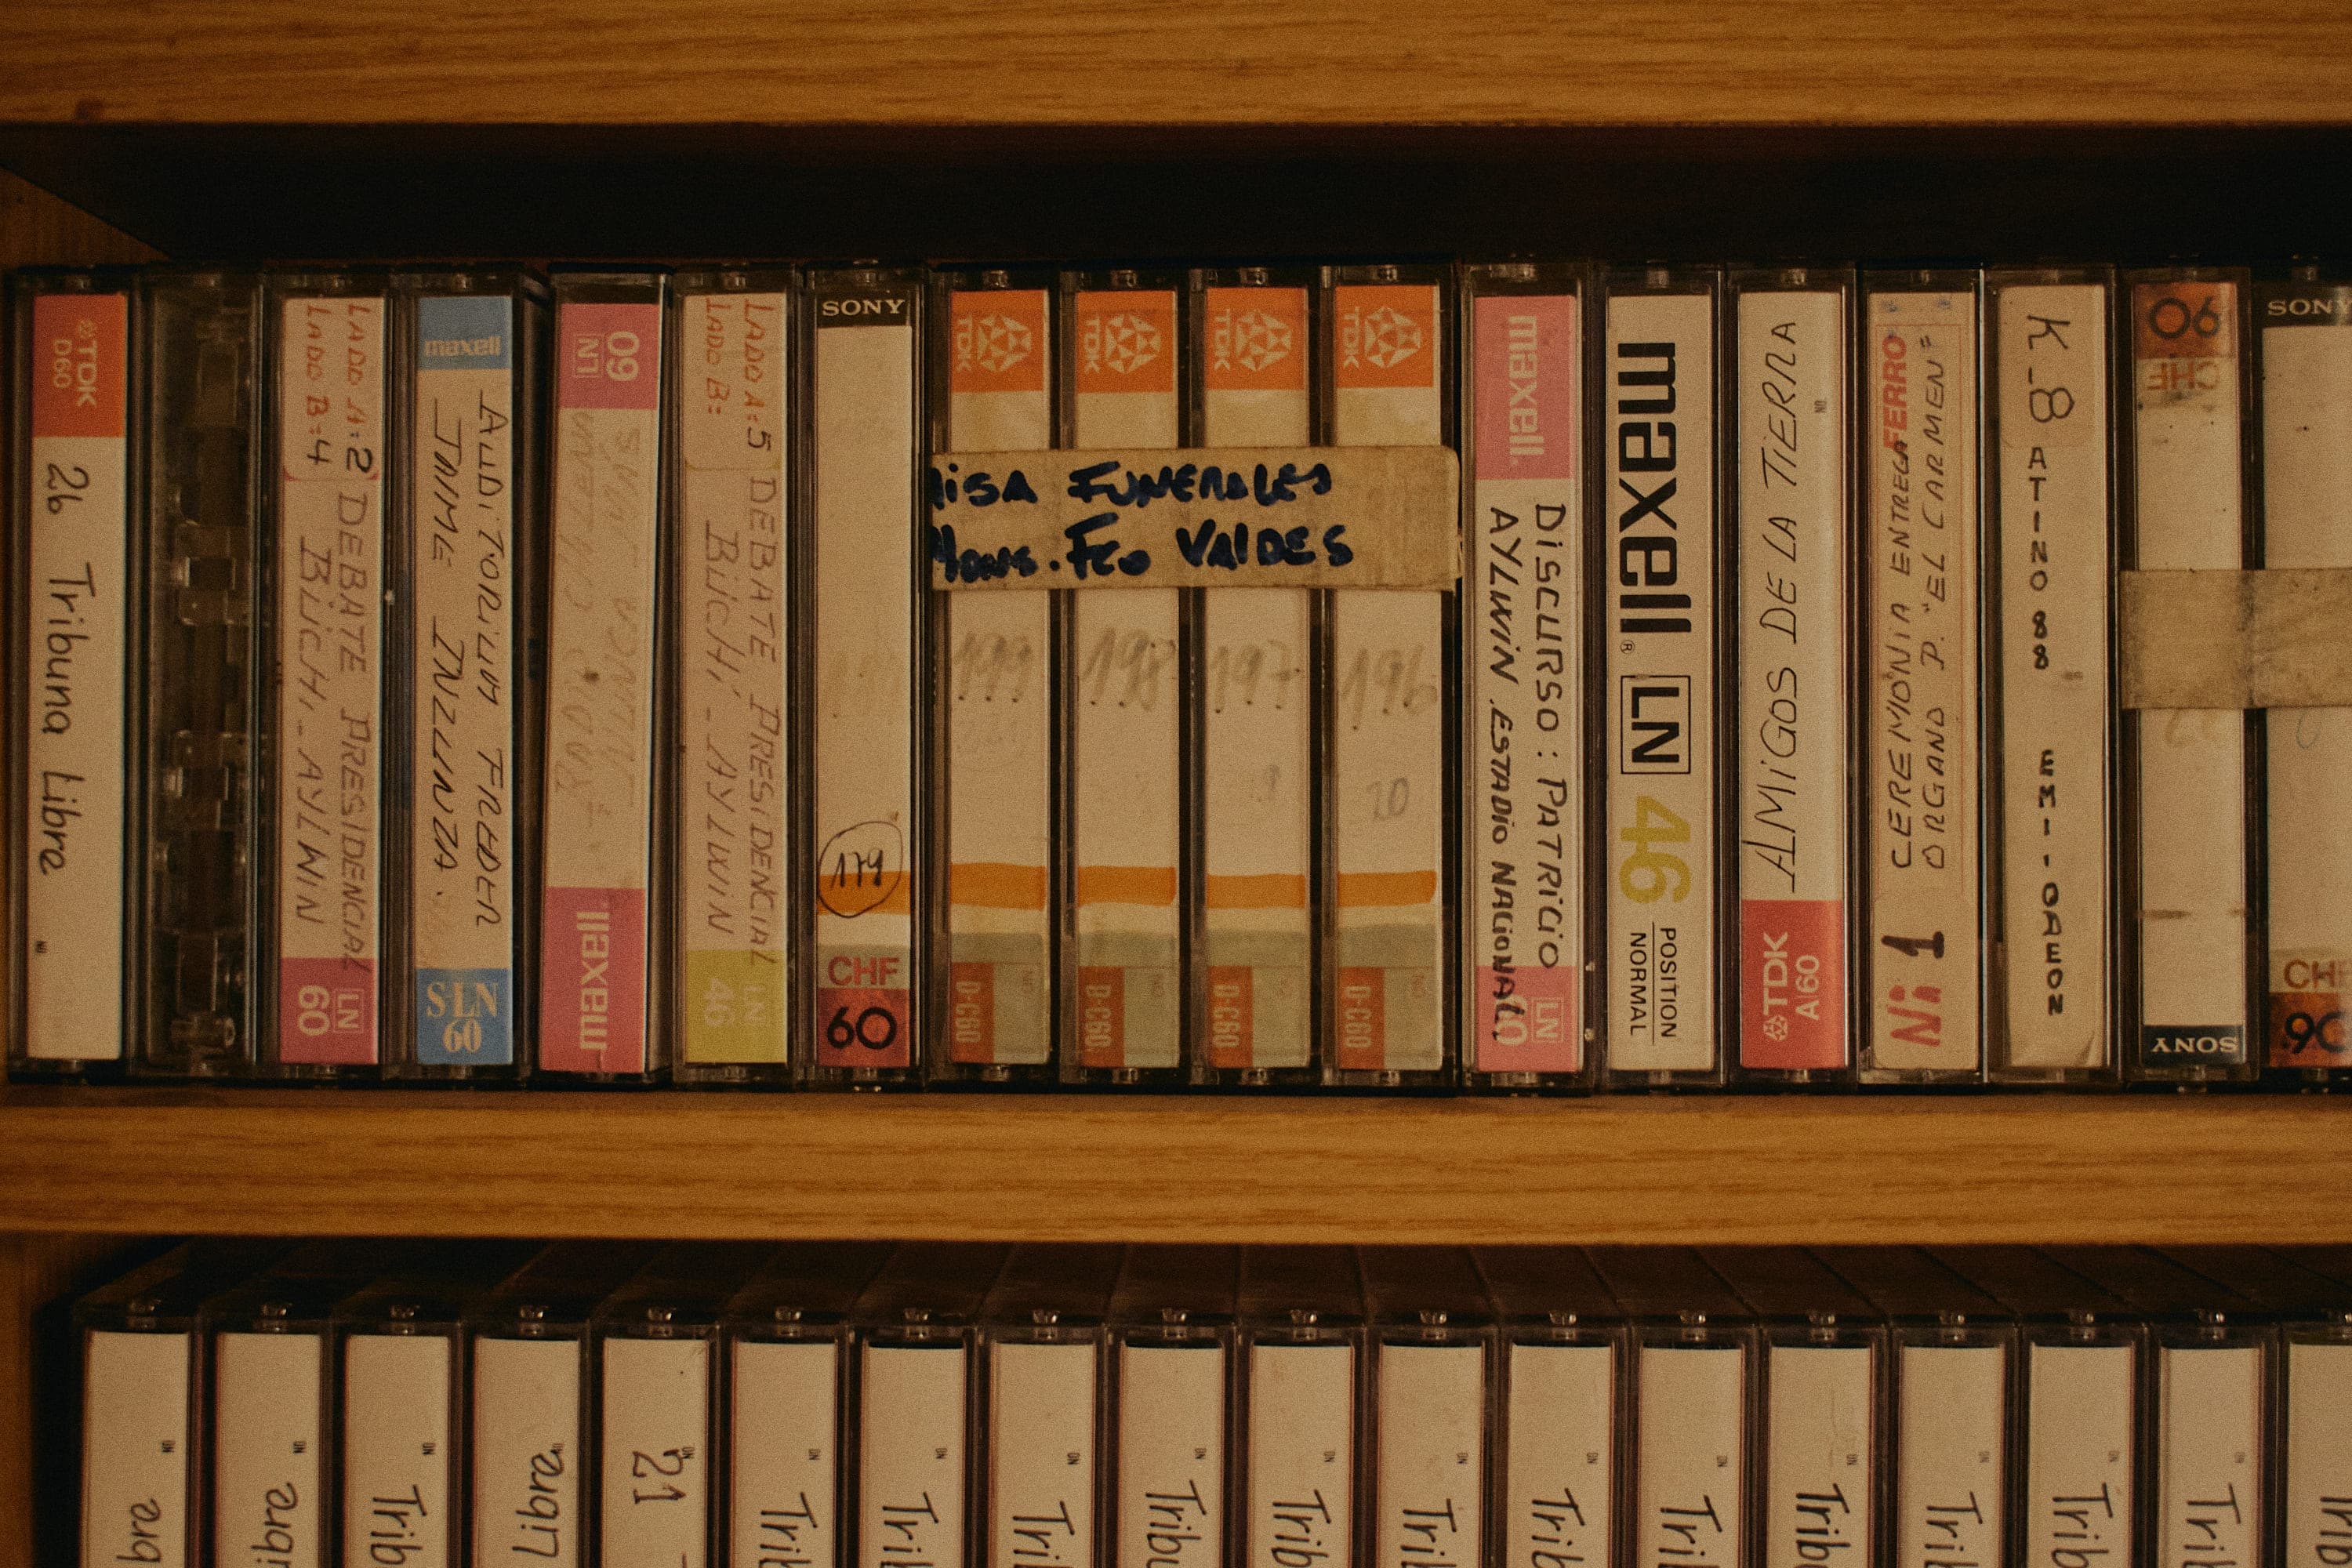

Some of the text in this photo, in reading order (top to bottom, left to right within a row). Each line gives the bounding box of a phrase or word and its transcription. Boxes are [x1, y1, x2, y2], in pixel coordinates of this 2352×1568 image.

[705, 298, 733, 365] LADO
[744, 299, 775, 383] LADO
[821, 299, 906, 316] SONY
[1214, 308, 1232, 372] TDK
[1343, 306, 1360, 369] TDK
[52, 338, 72, 389] D60
[76, 340, 97, 408] TDK
[306, 304, 331, 381] LADO
[347, 304, 371, 385] LADO
[424, 335, 501, 358] maxell
[577, 337, 599, 374] LN
[607, 330, 640, 382] 60
[956, 314, 973, 373] TDK
[1083, 314, 1101, 375] TDK
[2147, 360, 2221, 391] CHF
[1508, 315, 1544, 456] maxell
[1881, 335, 1908, 452] FERRO
[433, 398, 462, 568] JAIME
[1762, 517, 1797, 563] LA
[1759, 572, 1797, 644] DE
[43, 561, 96, 735] Tribuna
[338, 492, 372, 976] DEBATE PRESIDENCIAL
[749, 476, 781, 969] DEBATE PRESIDENCIAL
[1631, 686, 1681, 764] LN
[1740, 666, 1797, 893] AMIGOS
[39, 771, 86, 876] Libre
[296, 748, 330, 924] AYLWIN
[706, 733, 737, 935] AYLWIN
[1620, 795, 1692, 905] 46
[828, 956, 901, 987] CHF
[1763, 931, 1789, 1015] TDK
[1880, 931, 1944, 960] 1
[298, 985, 330, 1036] 60
[337, 992, 361, 1029] LN
[577, 910, 610, 1051] maxell
[702, 978, 735, 1028] 46
[744, 986, 766, 1023] LN
[1630, 932, 1648, 1036] NORMAL
[1660, 927, 1679, 1039] POSITION
[442, 1018, 482, 1053] 60
[826, 1006, 898, 1051] 60
[1536, 1001, 1559, 1038] LN
[2152, 1036, 2238, 1053] SONY
[511, 1448, 565, 1558] Libre
[631, 1448, 687, 1504] 21
